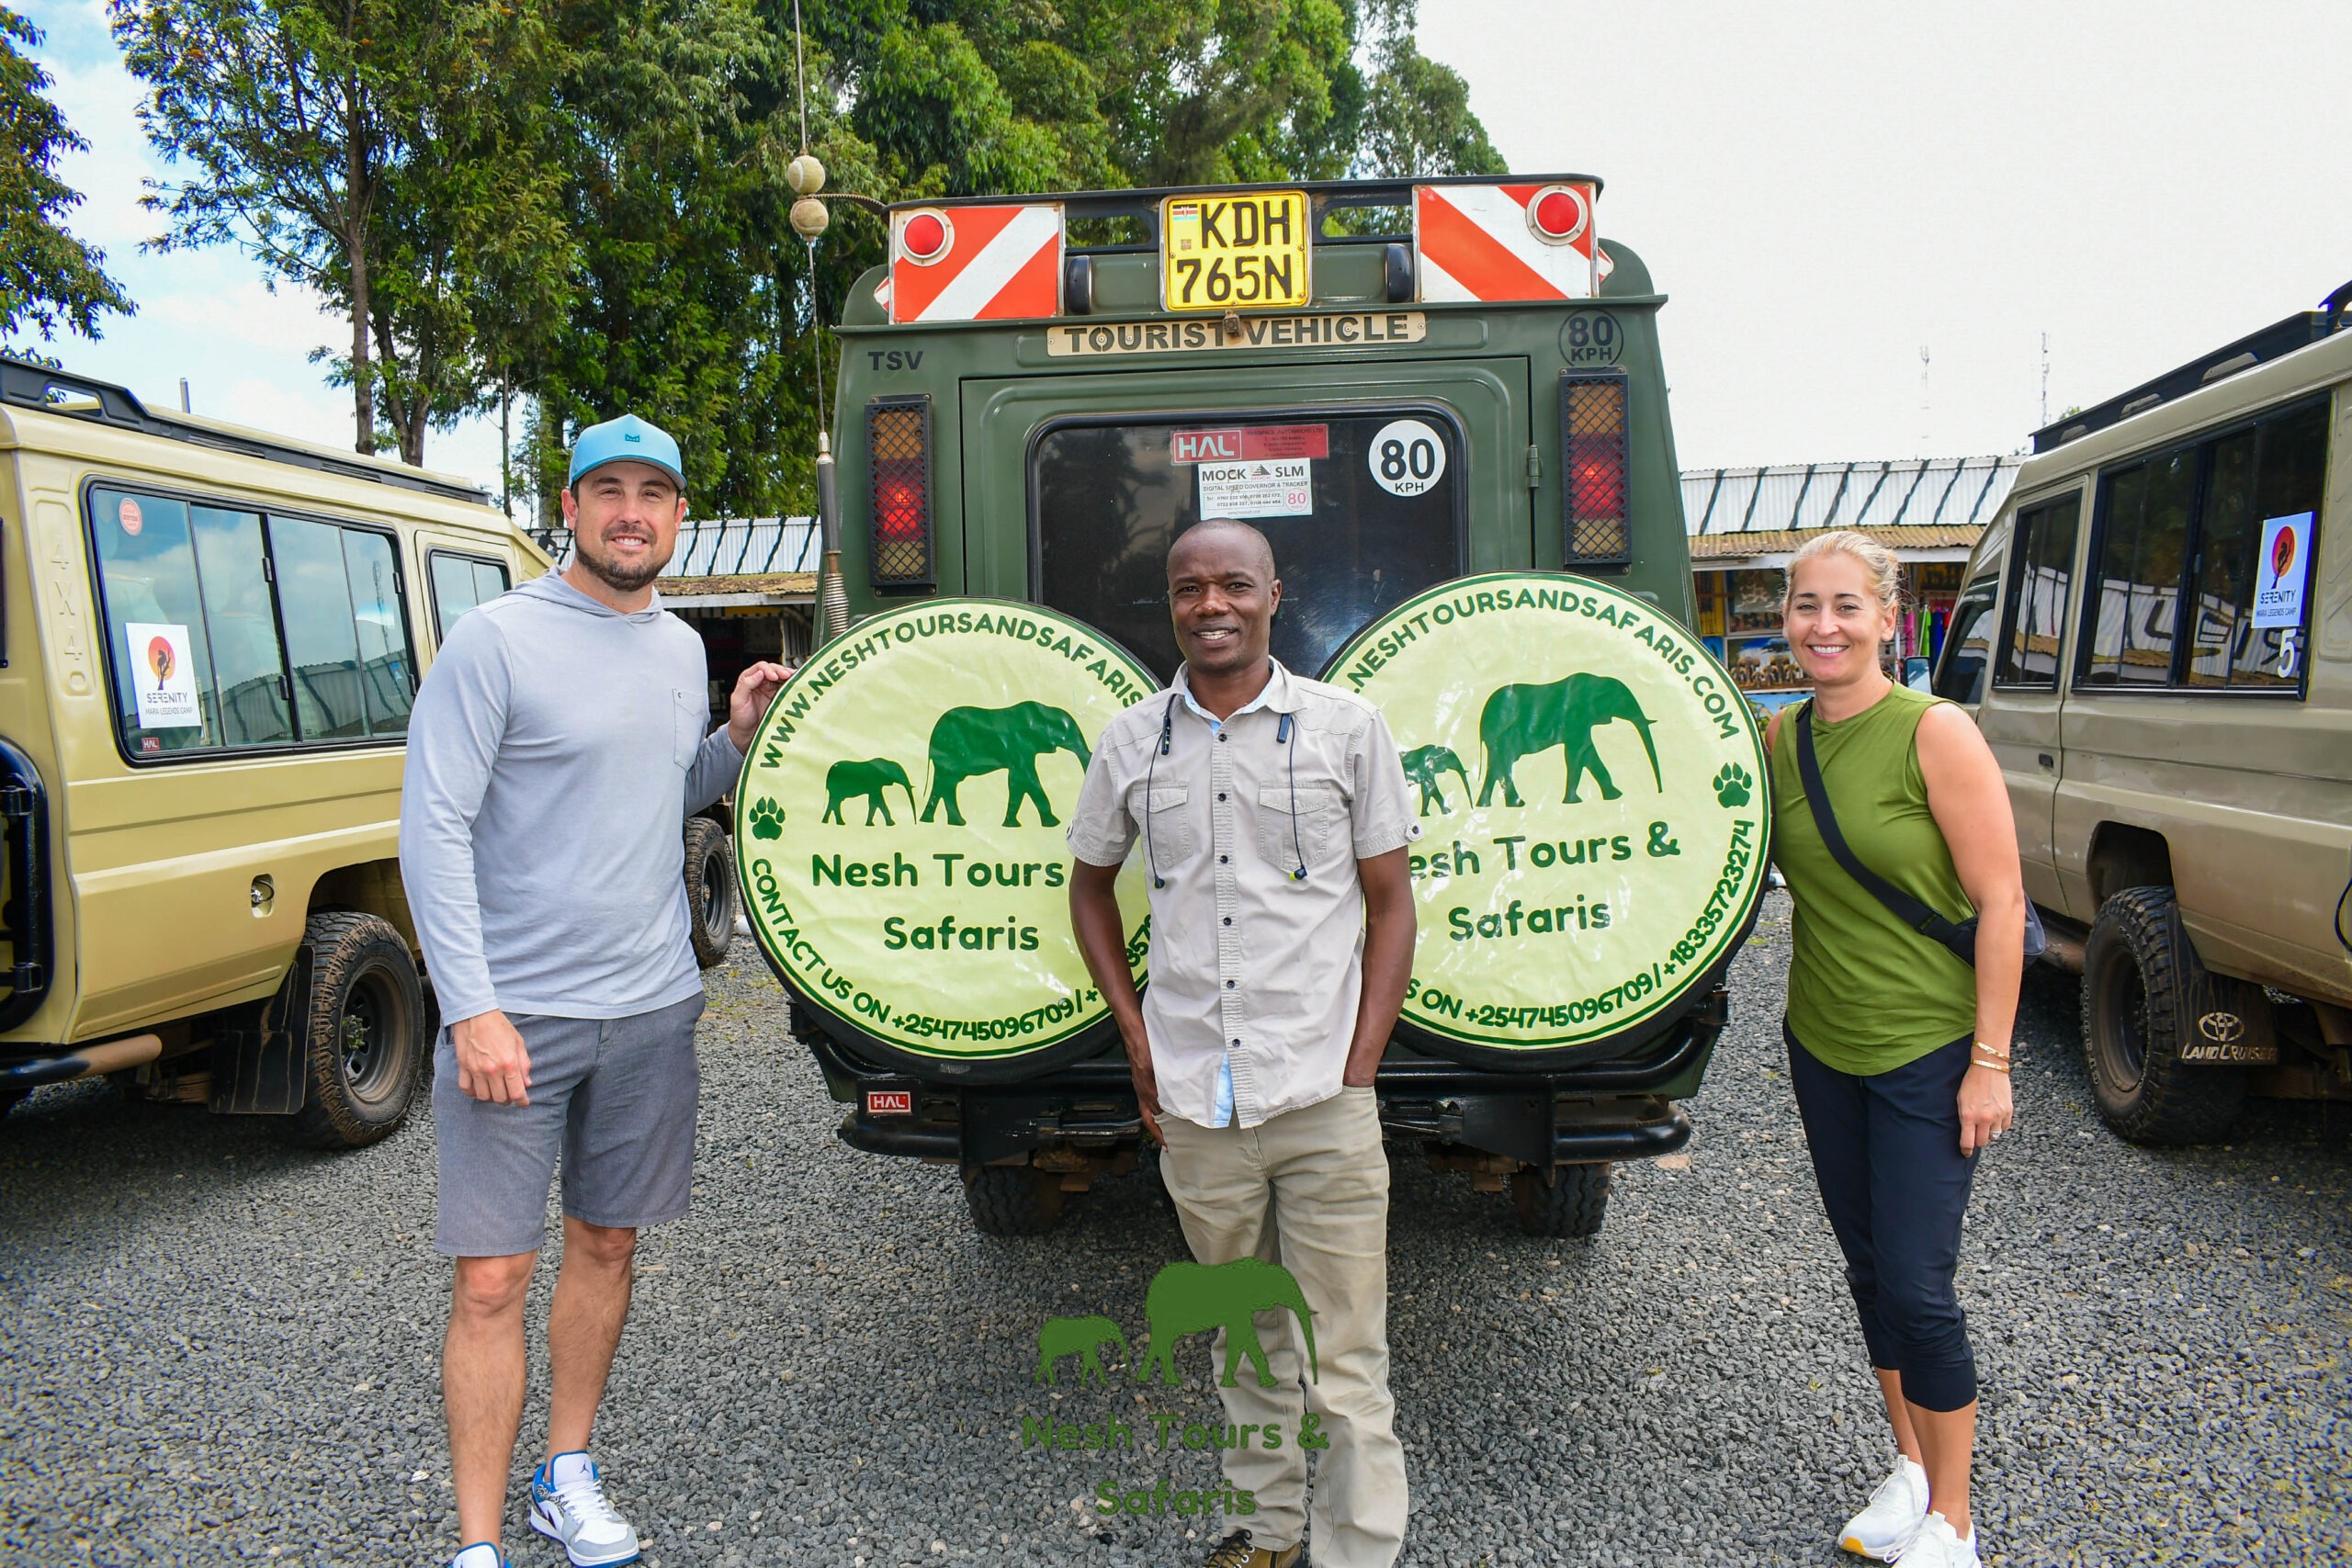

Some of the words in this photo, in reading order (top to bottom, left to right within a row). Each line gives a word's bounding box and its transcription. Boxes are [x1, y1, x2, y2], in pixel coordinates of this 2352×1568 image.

[1201, 199, 1291, 249] KDH
[1177, 254, 1293, 303] 765N
[1064, 322, 1226, 353] TOURIST
[1244, 315, 1408, 345] VEHICLE
[1568, 316, 1613, 347] 80
[867, 351, 923, 370] TSV
[1571, 347, 1612, 361] KPH
[1179, 434, 1235, 458] HAL
[1381, 438, 1435, 480] 80
[1202, 468, 1246, 481] MOCK
[1275, 466, 1304, 478] SLM
[1395, 482, 1424, 493] KPH
[1288, 492, 1306, 504] 80
[2256, 609, 2267, 617] MARA
[2267, 608, 2284, 616] LEGENDS
[2285, 607, 2297, 615] CAMP
[2260, 590, 2296, 604] SERENITY
[1354, 589, 1739, 739] .NESHTOURSANDSAFARIS.COM
[2278, 628, 2297, 678] 5
[147, 693, 187, 704] SERENITY
[760, 612, 1144, 769] WWW.NESHTOURSANDSAFARIS
[1409, 840, 1480, 880] esh
[1493, 833, 1632, 869] Tours
[1645, 821, 1680, 857] &
[812, 852, 918, 887] Nesh
[933, 853, 1065, 887] Tours
[884, 916, 1040, 951] Safaris
[1449, 895, 1611, 942] Safaris
[752, 858, 827, 972] CONTACT
[821, 967, 854, 999] US
[854, 992, 891, 1023] ON
[1406, 978, 1421, 999] S
[1421, 989, 1463, 1019] ON
[874, 1096, 906, 1109] HAL
